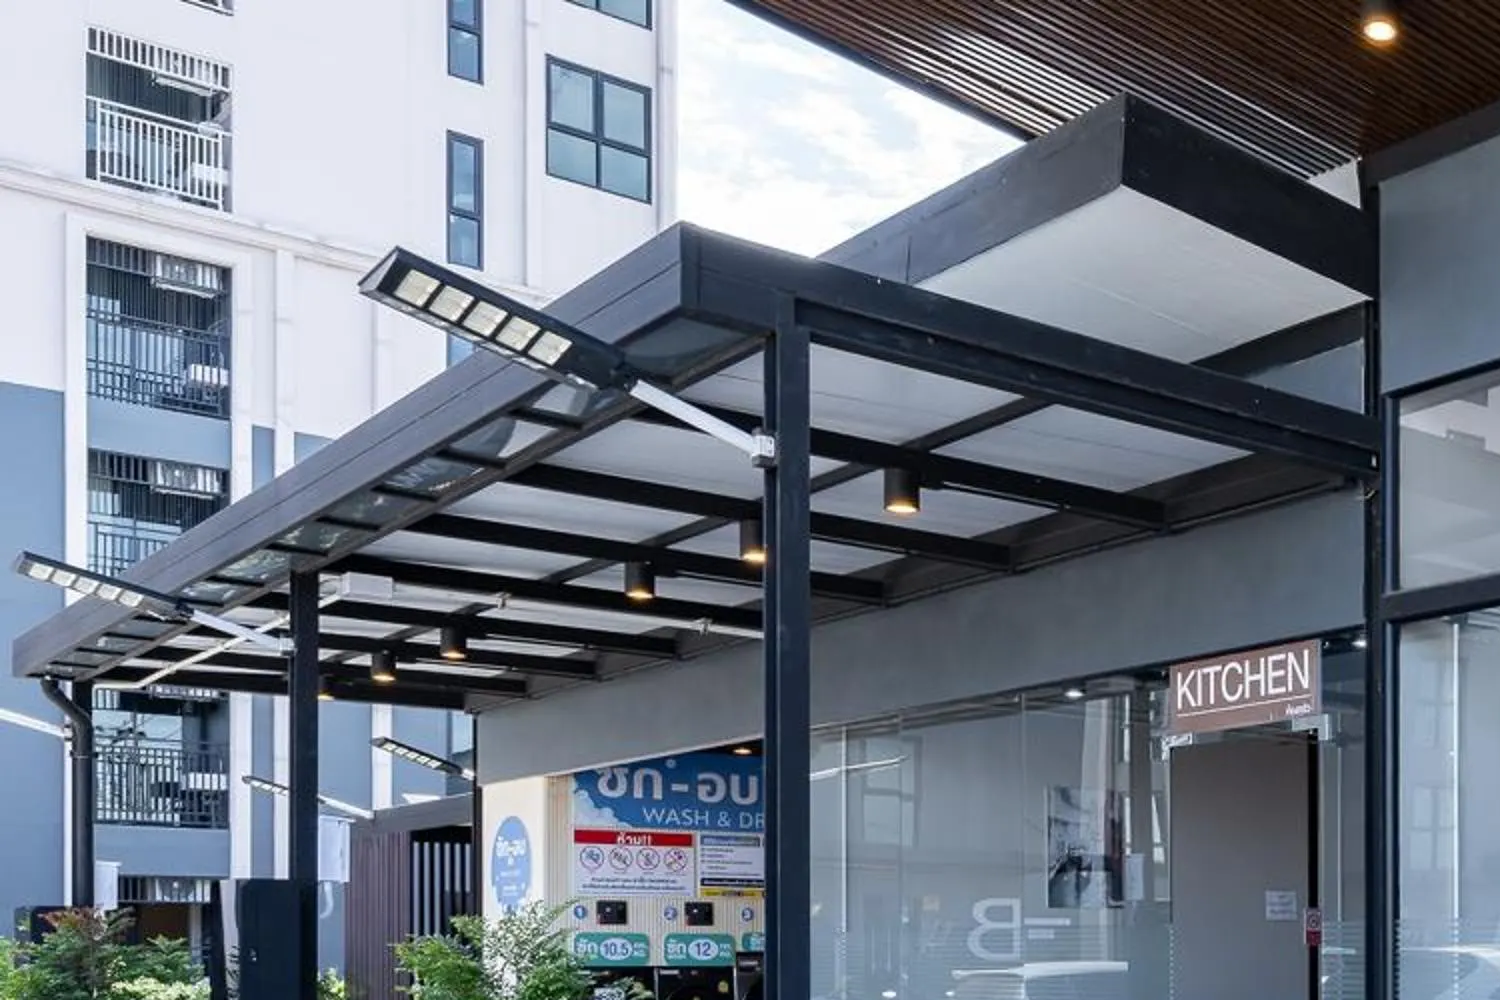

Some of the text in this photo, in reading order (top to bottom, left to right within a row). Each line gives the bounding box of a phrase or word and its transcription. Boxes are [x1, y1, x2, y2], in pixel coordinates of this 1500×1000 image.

[1176, 649, 1310, 710] KITCHEN
[697, 771, 759, 805] อบ
[642, 806, 710, 827] WASH
[717, 811, 731, 827] &
[602, 941, 630, 957] 10.5
[694, 941, 712, 957] 12
